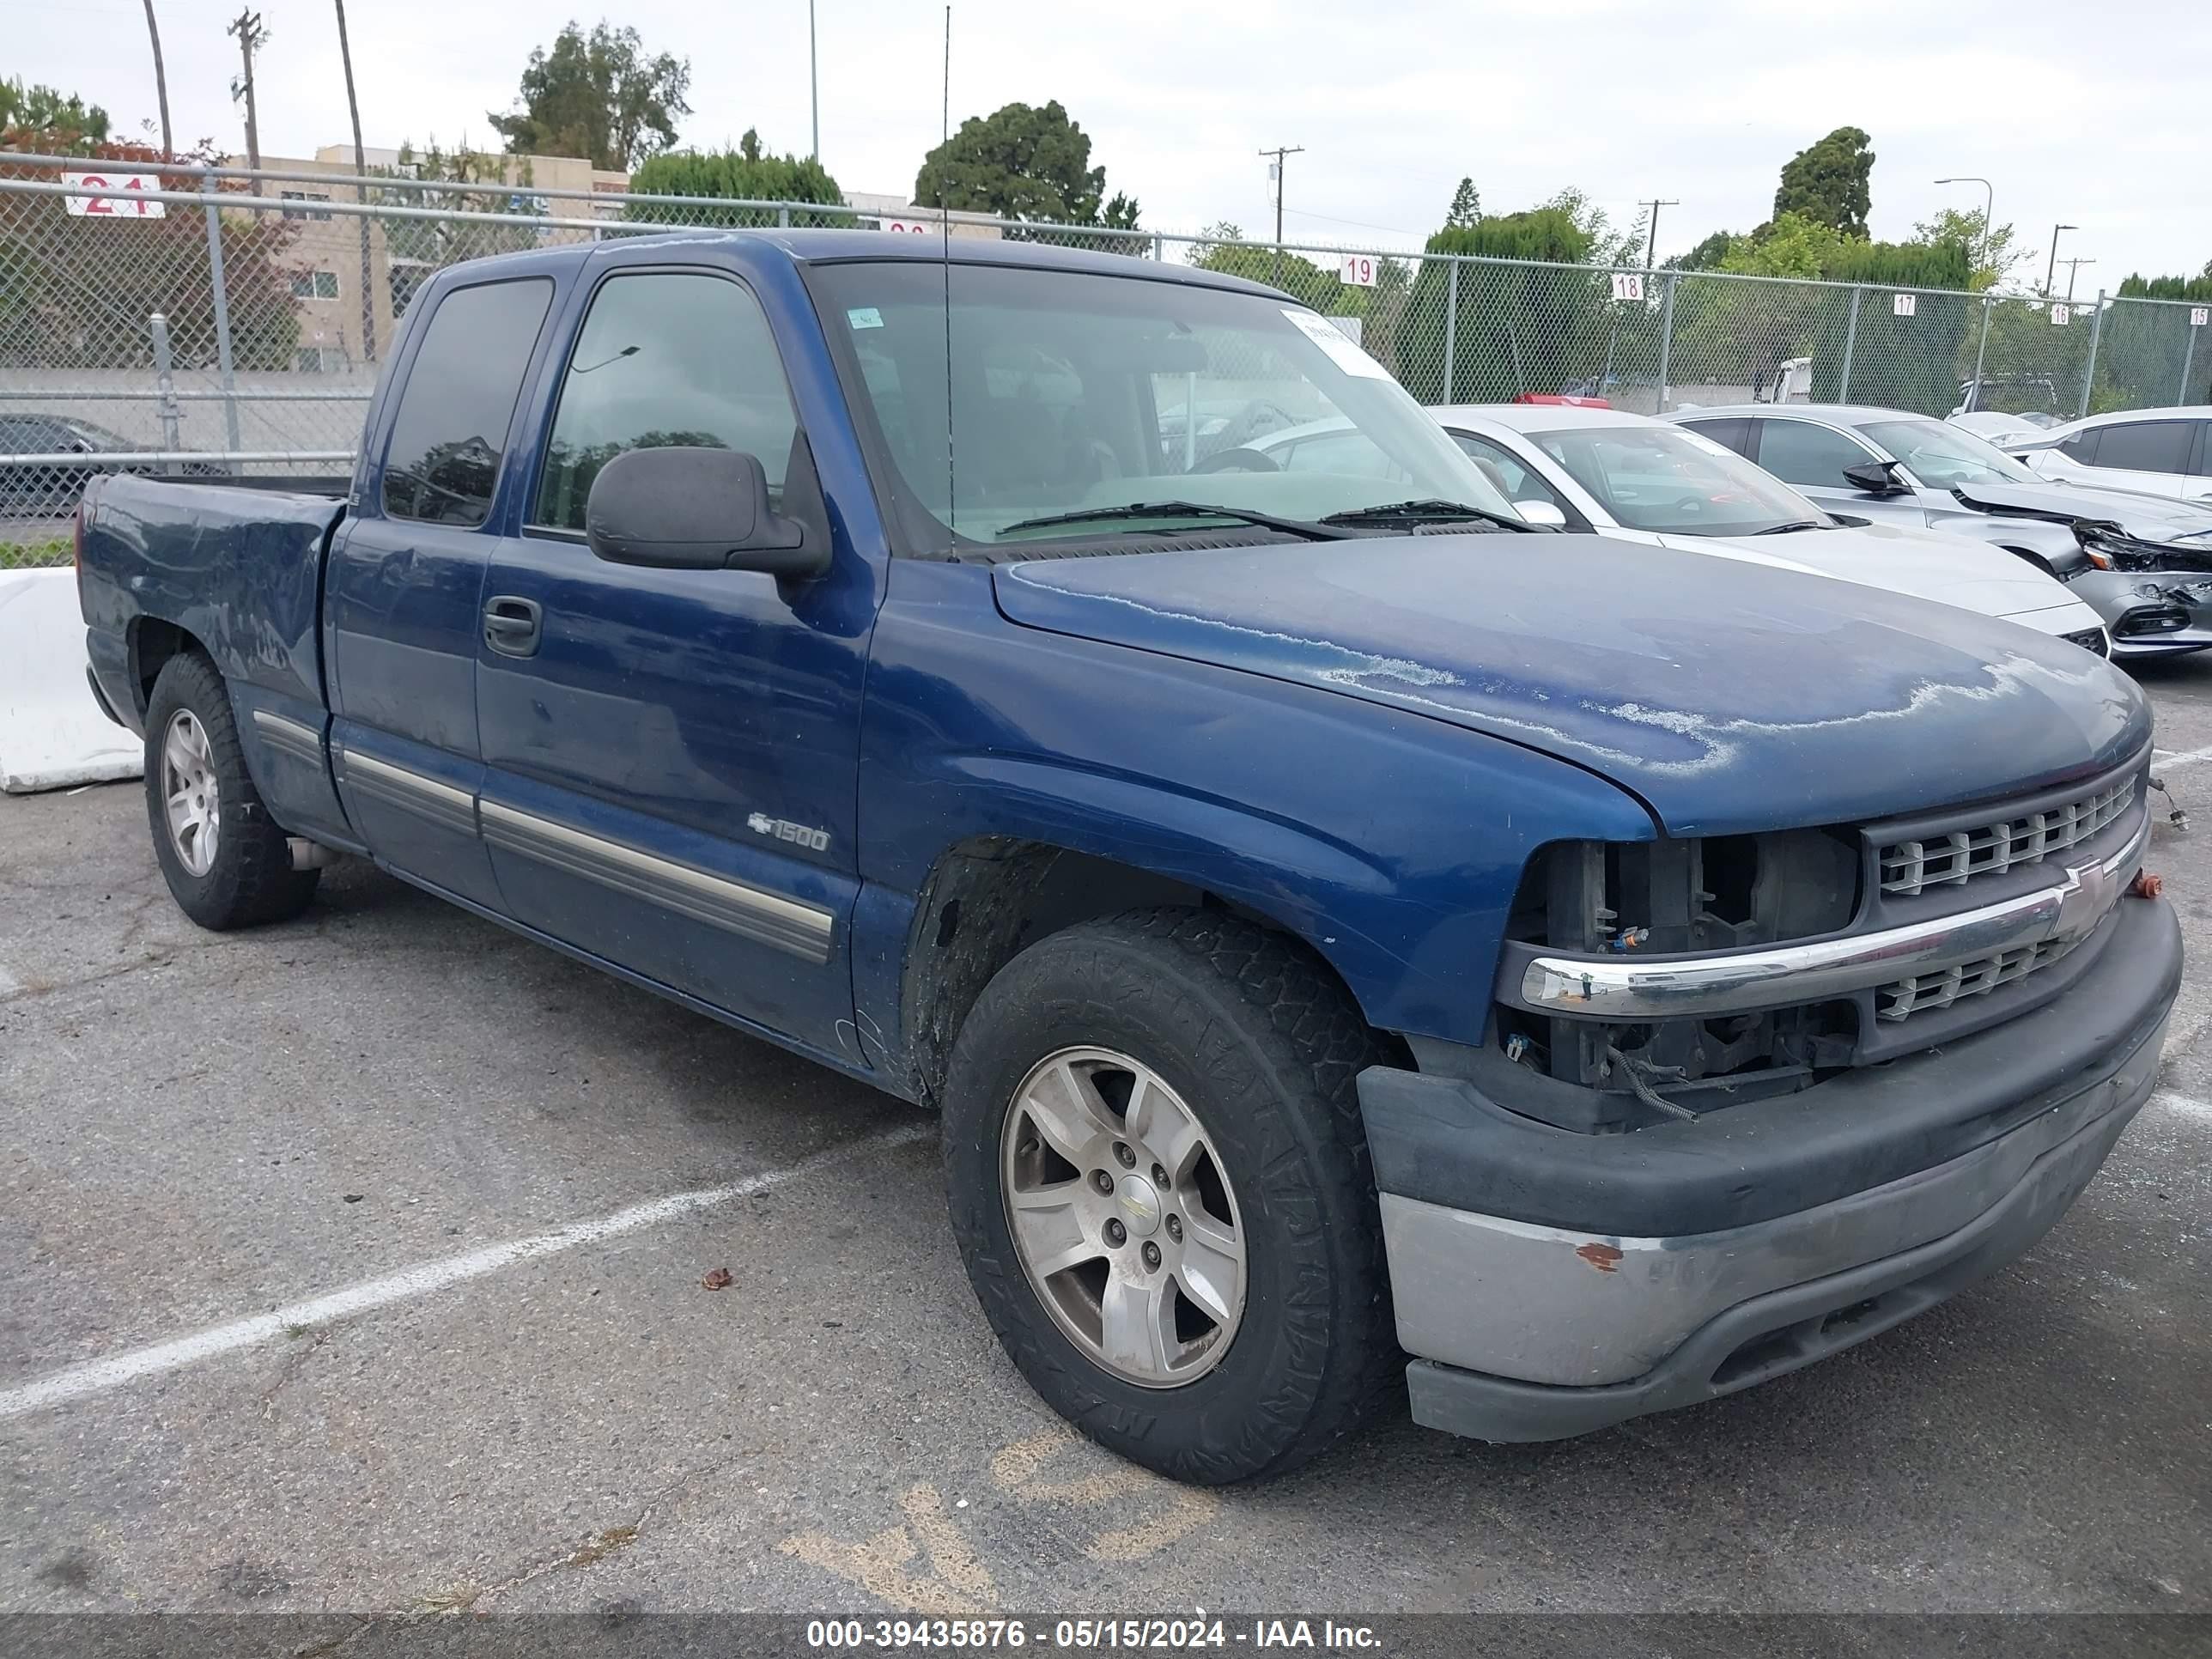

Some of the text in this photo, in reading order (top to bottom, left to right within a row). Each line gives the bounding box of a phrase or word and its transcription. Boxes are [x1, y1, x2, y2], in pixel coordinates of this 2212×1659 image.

[82, 176, 148, 215] 21
[1348, 258, 1370, 283] 19
[1618, 276, 1638, 298] 18
[1899, 295, 1912, 314] 17
[2056, 307, 2066, 324] 16
[2194, 309, 2205, 324] 15
[774, 818, 830, 852] 1500
